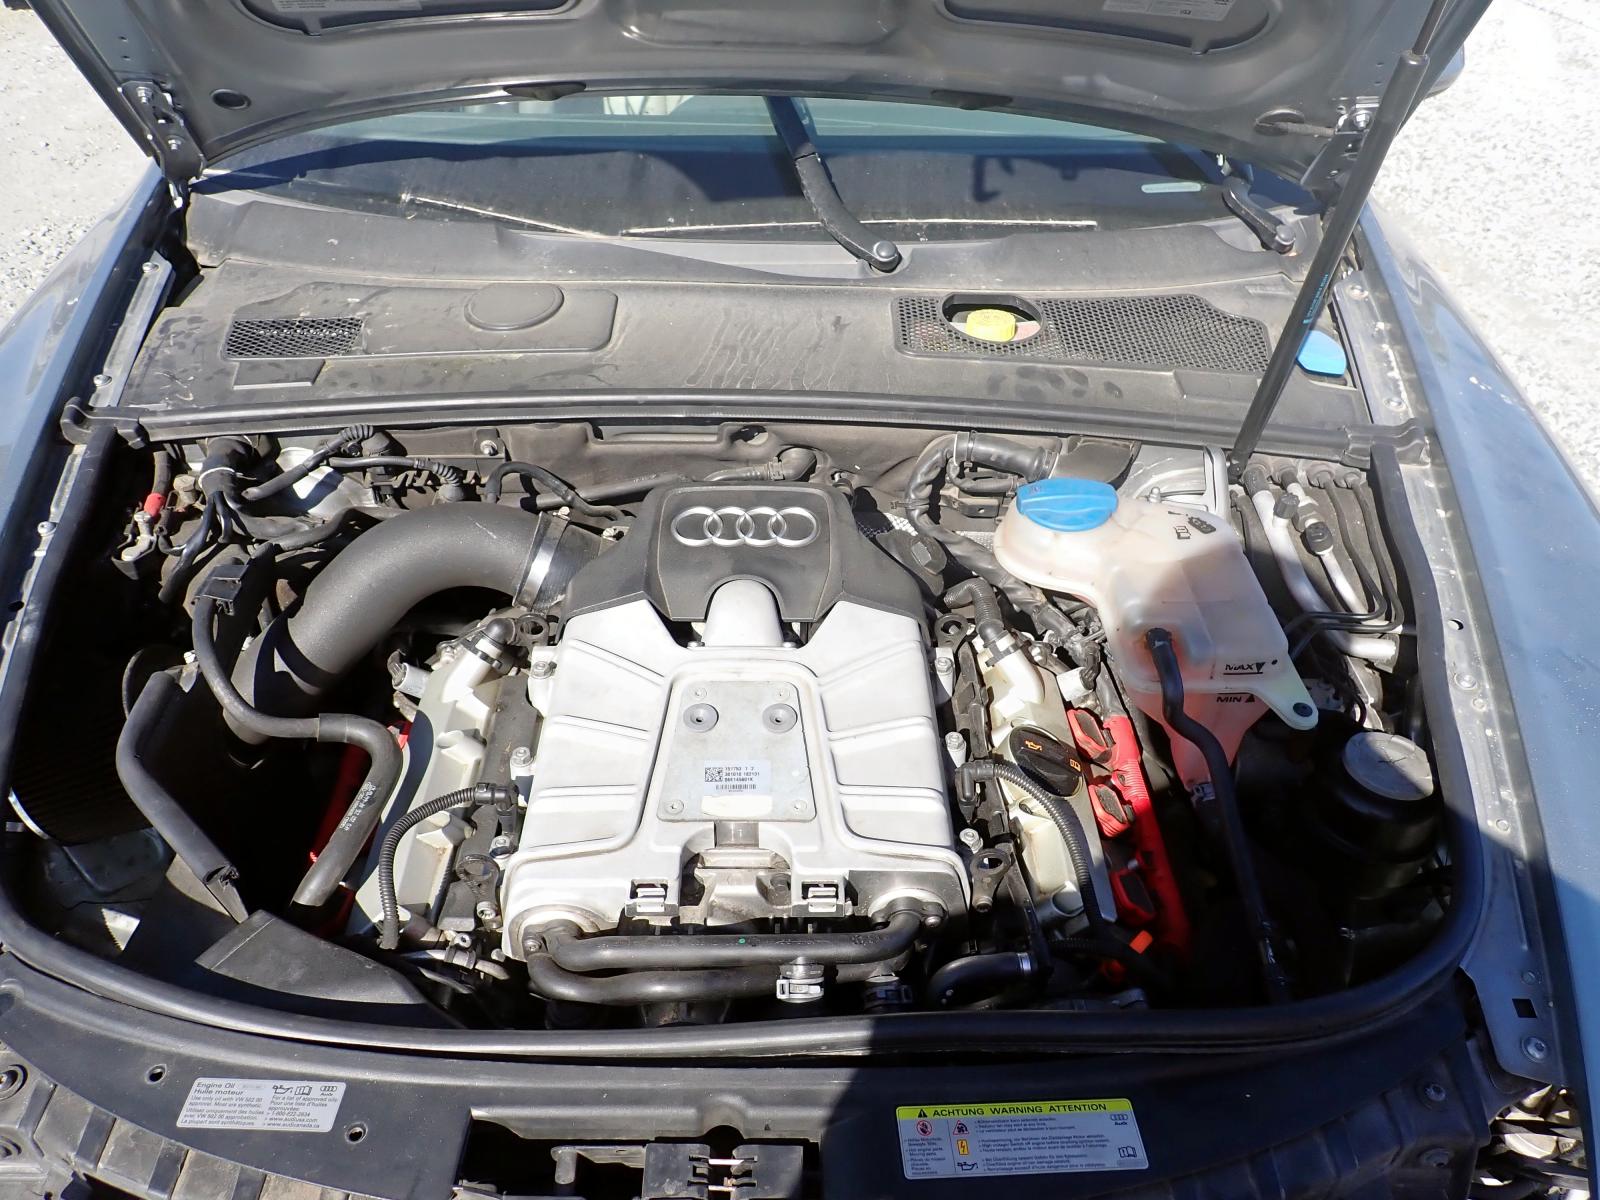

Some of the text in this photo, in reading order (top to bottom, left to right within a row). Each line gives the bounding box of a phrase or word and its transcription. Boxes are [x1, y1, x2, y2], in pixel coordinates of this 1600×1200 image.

[932, 1103, 1107, 1117] ACHTUNG WARNING ATTENTION
